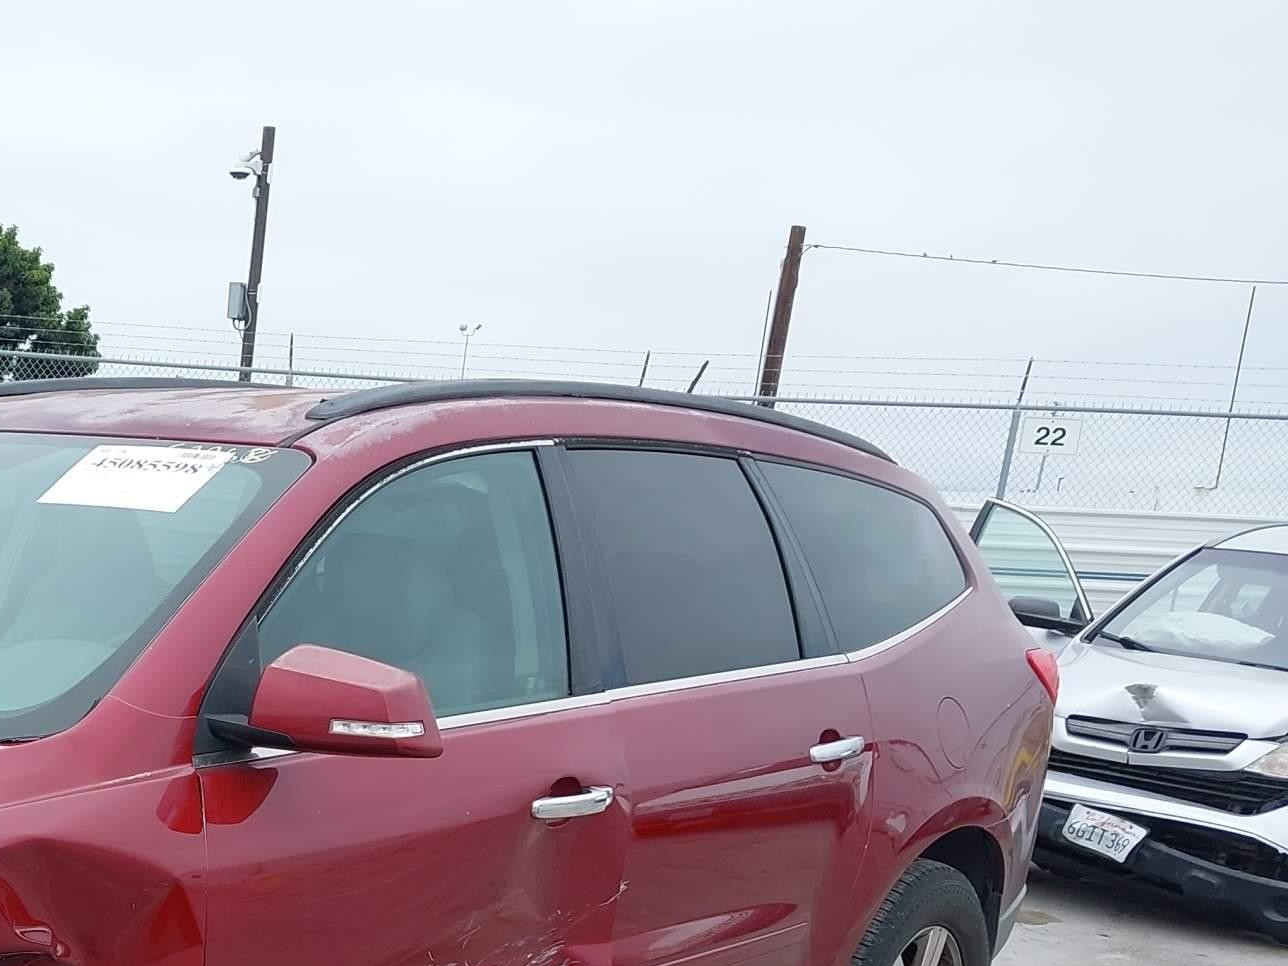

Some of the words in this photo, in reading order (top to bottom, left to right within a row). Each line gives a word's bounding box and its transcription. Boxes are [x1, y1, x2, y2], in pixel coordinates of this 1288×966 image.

[1033, 426, 1067, 446] 22
[91, 457, 203, 475] 45085598
[1067, 820, 1130, 854] 6GIT369
